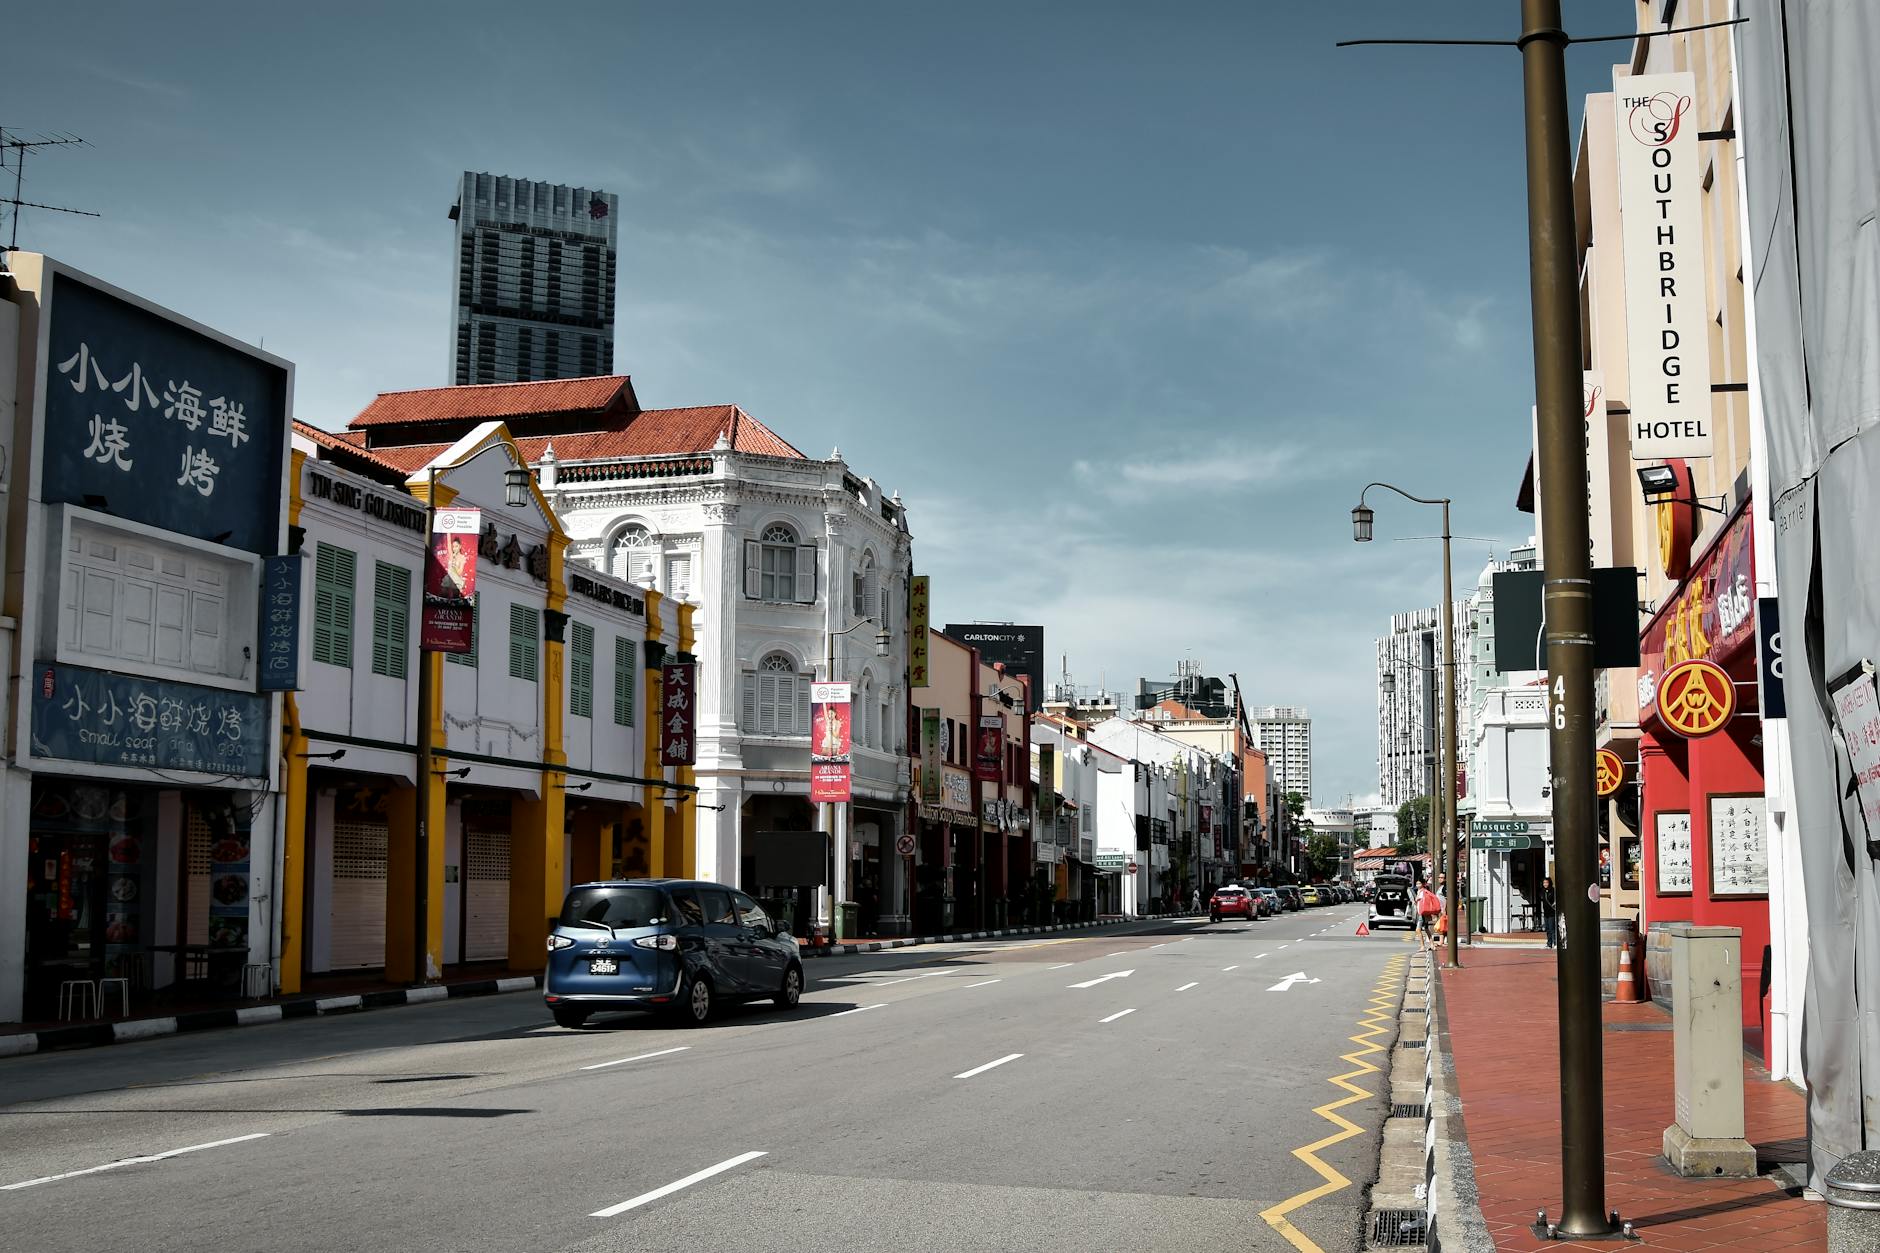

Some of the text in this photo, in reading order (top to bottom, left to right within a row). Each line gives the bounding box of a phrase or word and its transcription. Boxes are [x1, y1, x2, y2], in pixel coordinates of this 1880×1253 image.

[1622, 96, 1650, 109] THE
[1651, 122, 1682, 405] SOUTHBRIDGE
[57, 341, 250, 449] 小小海鲜
[1636, 420, 1708, 440] HOTEL
[310, 470, 333, 500] TIN
[912, 582, 926, 681] 北京同仁堂
[1553, 675, 1566, 731] 46
[1473, 822, 1525, 832] Mosque St
